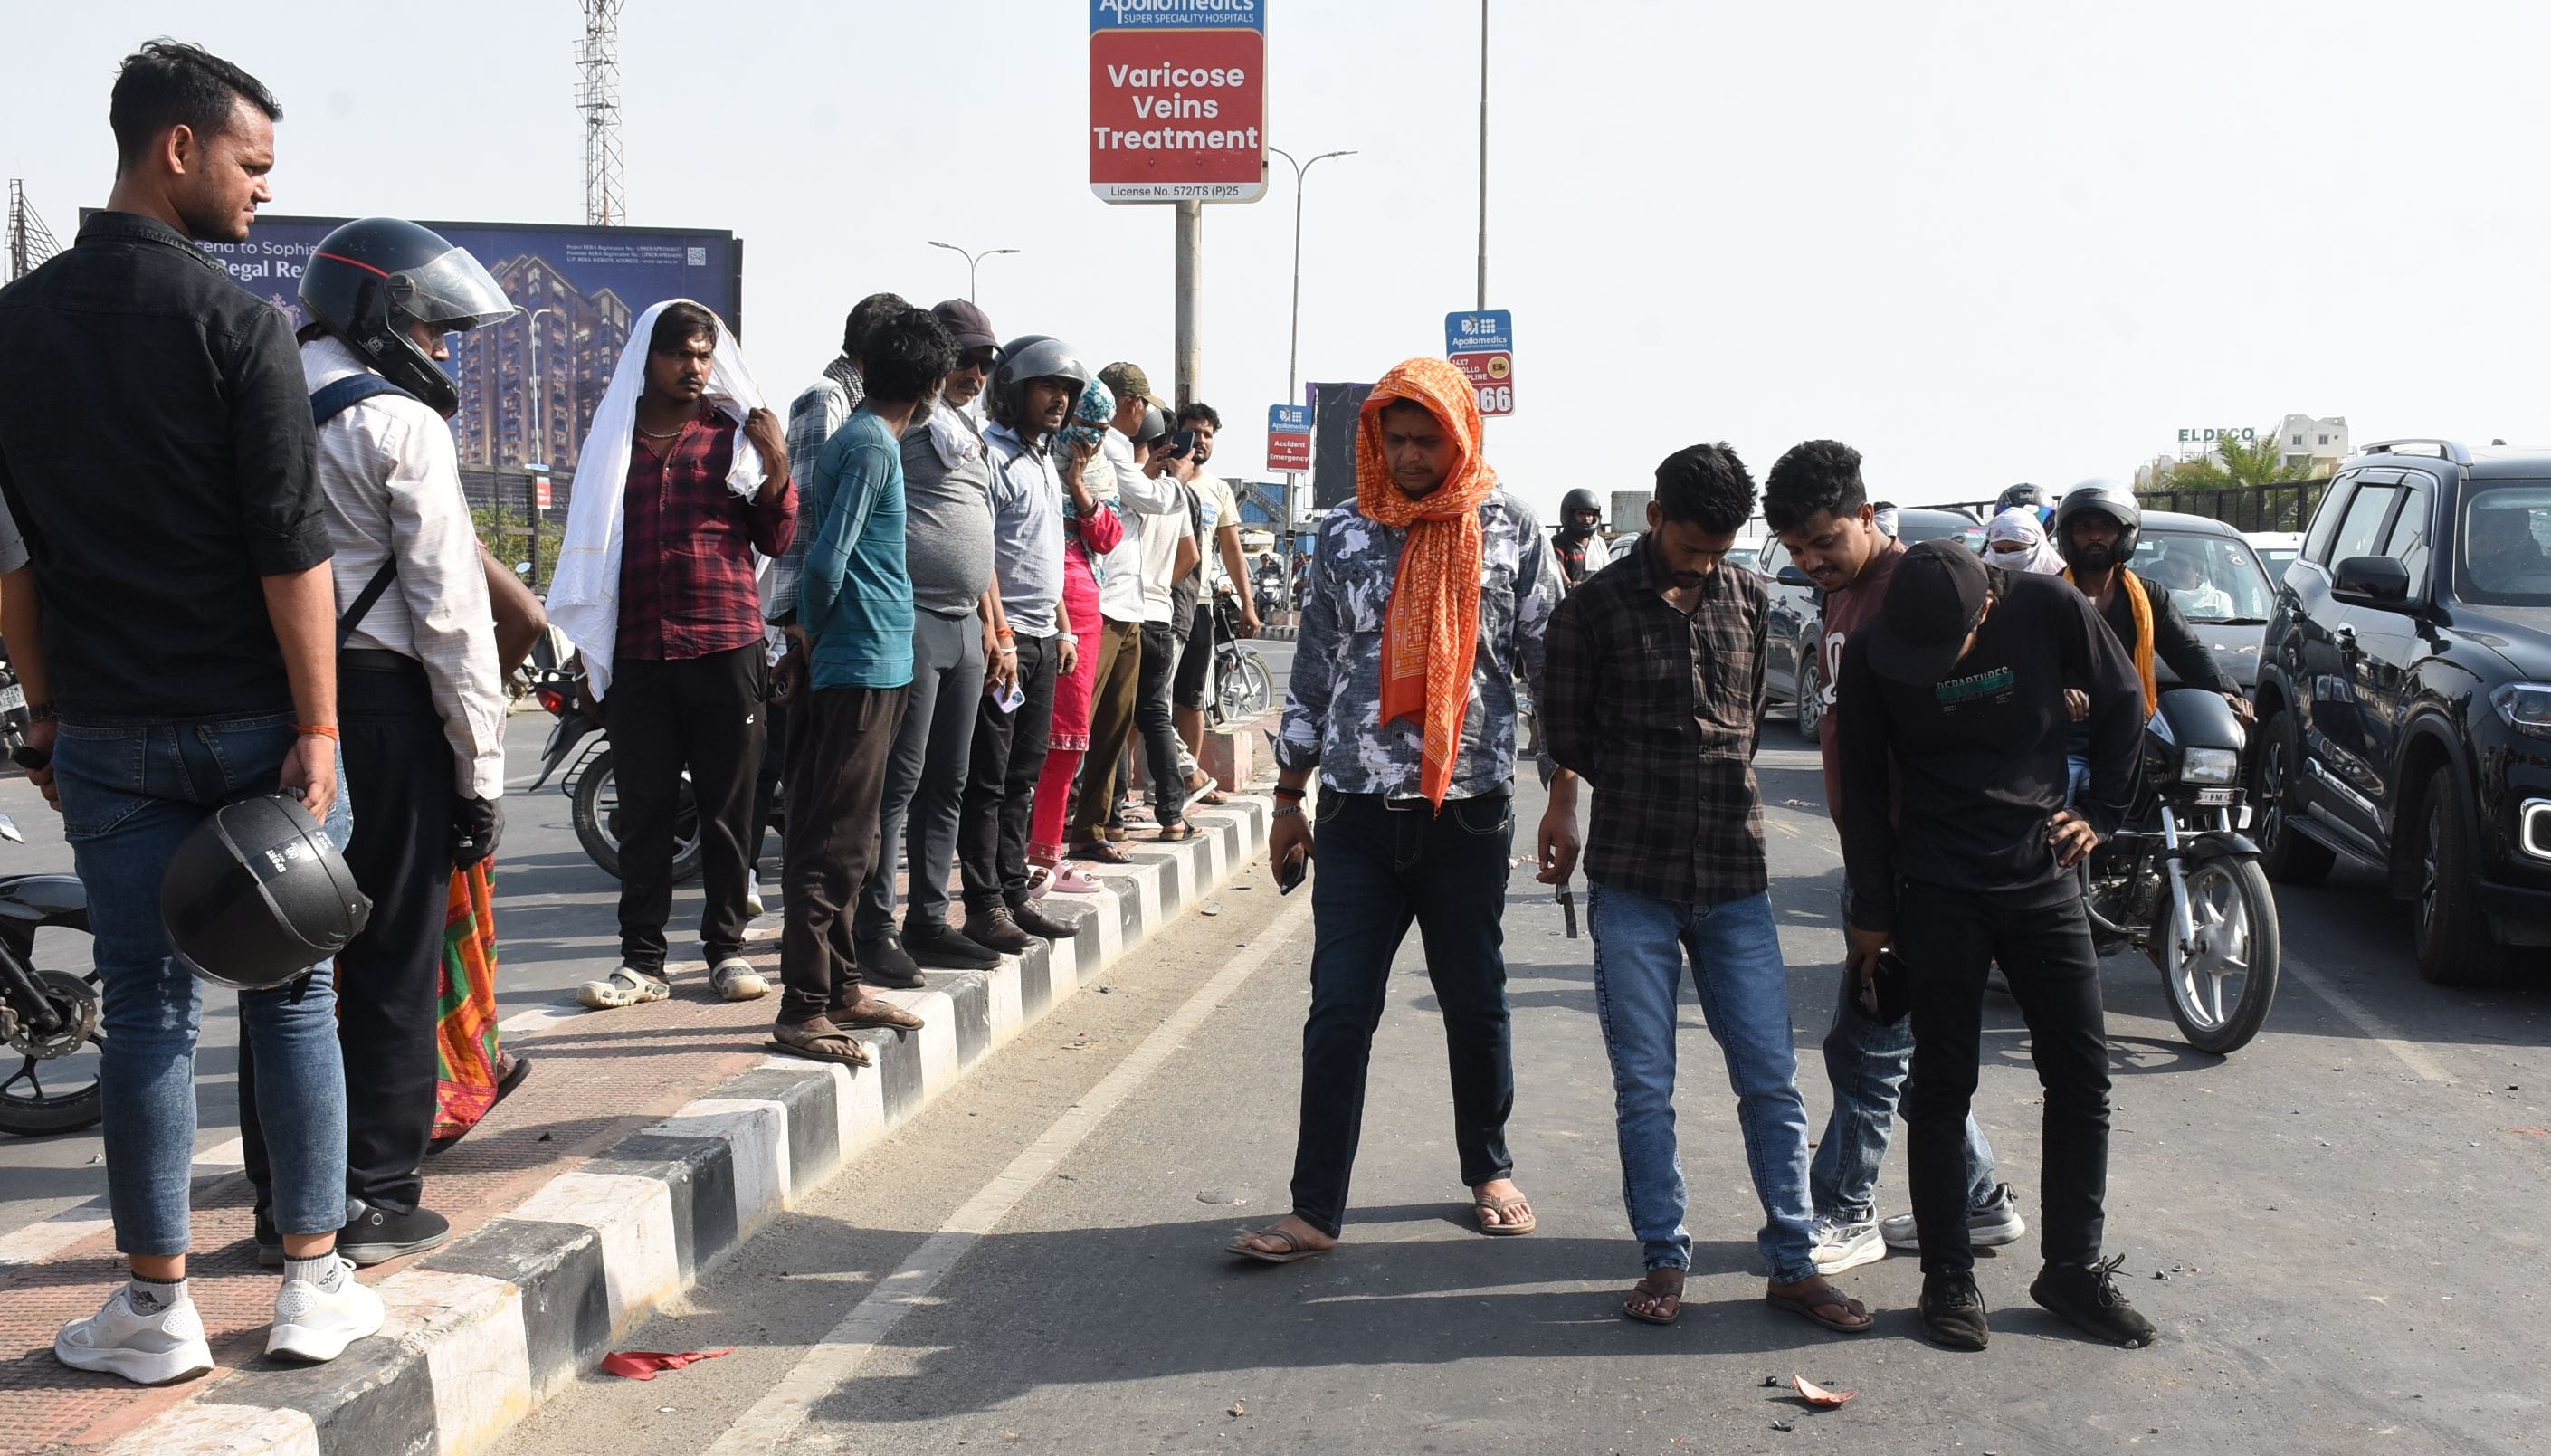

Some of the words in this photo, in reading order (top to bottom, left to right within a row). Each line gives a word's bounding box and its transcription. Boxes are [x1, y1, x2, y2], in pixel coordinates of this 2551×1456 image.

[1124, 14, 1153, 24] SUPER
[1155, 14, 1204, 23] SPECIALITY
[1205, 14, 1254, 23] HOSPITALS
[1107, 61, 1245, 88] Varicose
[1132, 92, 1219, 119] Veins
[1093, 126, 1259, 150] Treatment
[1111, 186, 1151, 196] License
[1153, 186, 1171, 196] No.
[1174, 186, 1209, 196] 572/TS
[1212, 186, 1239, 198] (P)25
[240, 243, 258, 254] to
[262, 241, 318, 257] Sophis
[1452, 335, 1508, 349] Apollomedics
[1474, 386, 1511, 413] 66
[2178, 427, 2255, 442] ELDECO
[1274, 440, 1306, 448] Accident
[1270, 453, 1309, 463] Emergency
[2209, 794, 2223, 802] FM
[264, 849, 287, 873] SPORT
